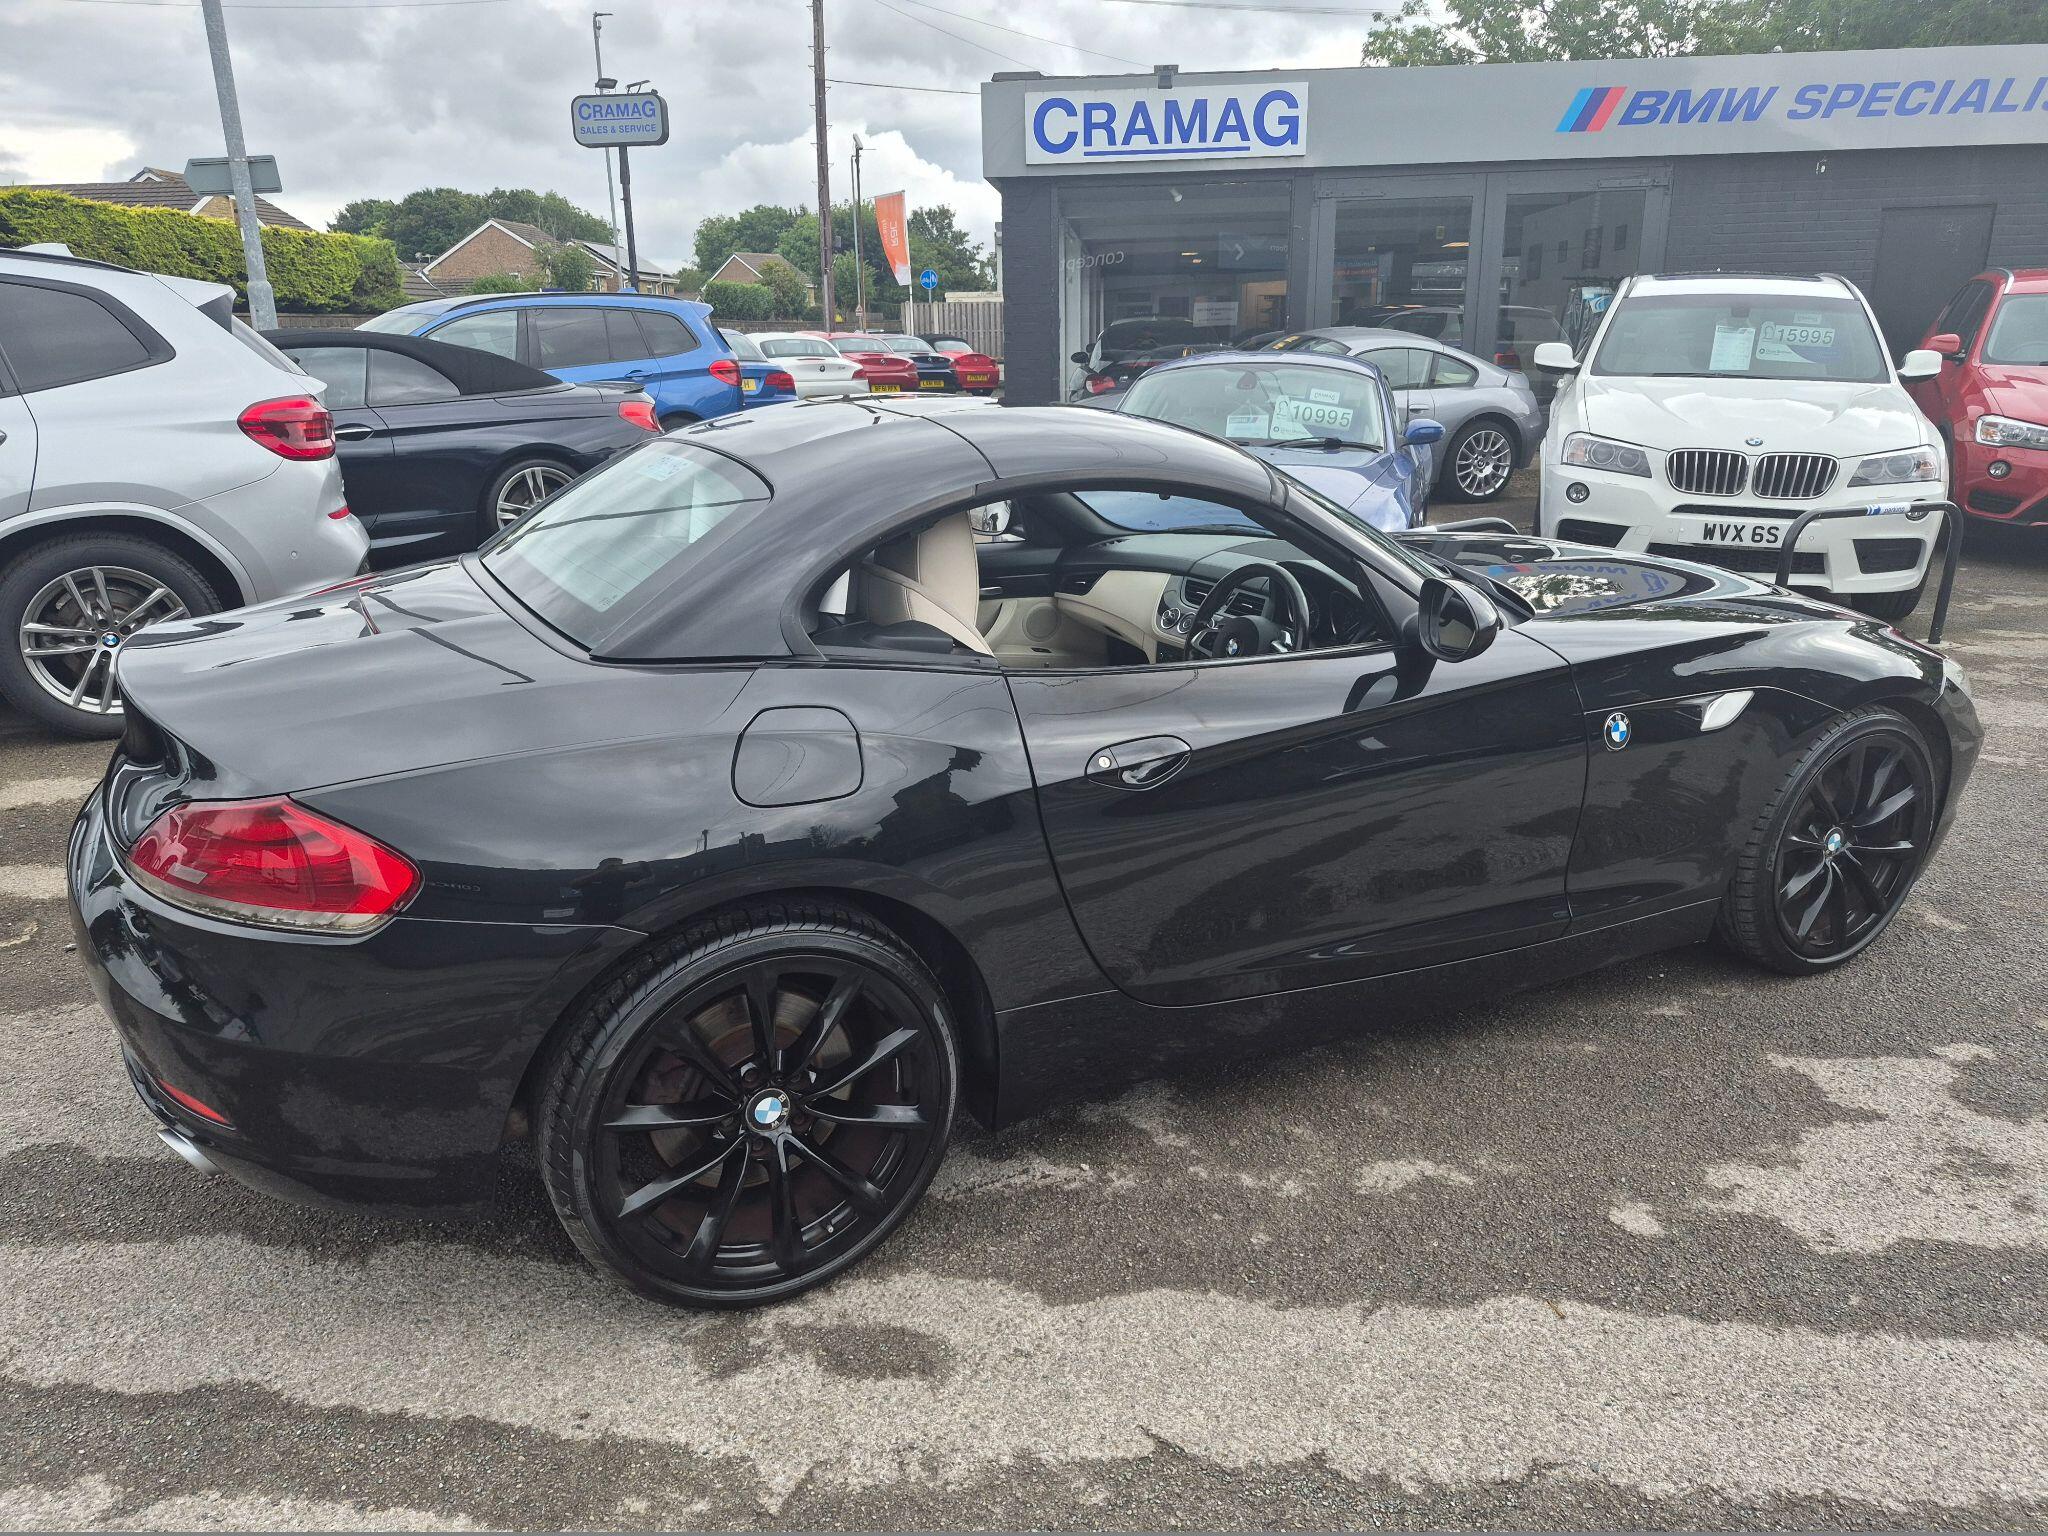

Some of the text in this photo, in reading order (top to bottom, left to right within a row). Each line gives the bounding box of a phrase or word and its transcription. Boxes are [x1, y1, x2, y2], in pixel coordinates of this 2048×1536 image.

[578, 100, 656, 121] CRAMAG
[1617, 76, 2048, 126] BMW SPECIALI
[580, 123, 657, 135] SALES & SERVICE
[1033, 90, 1300, 154] CRAMAG
[1702, 522, 1780, 543] WVX 6S
